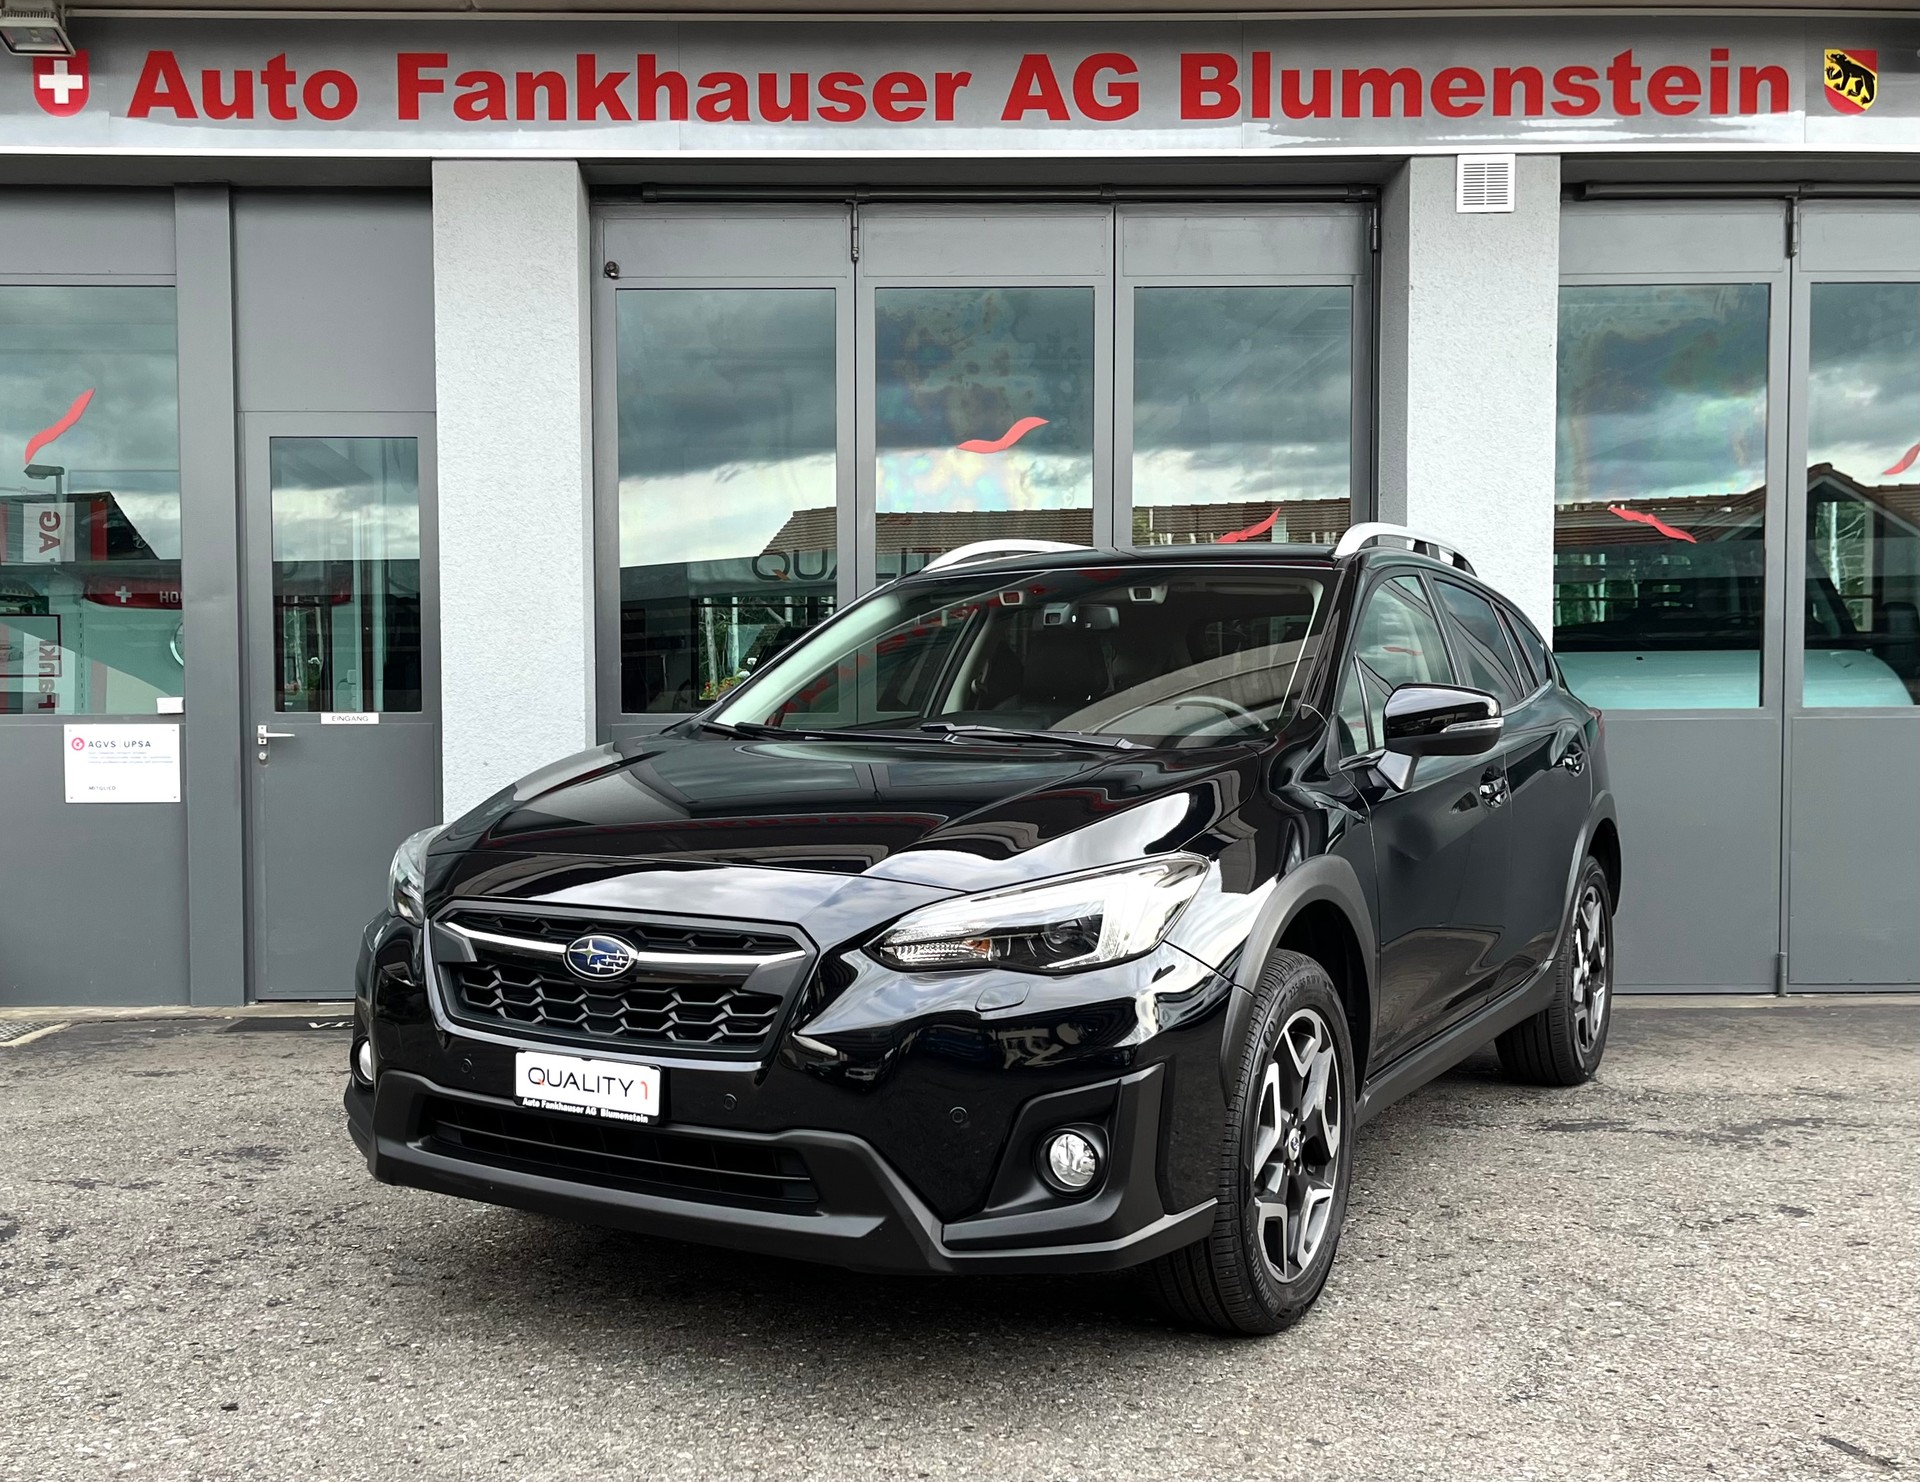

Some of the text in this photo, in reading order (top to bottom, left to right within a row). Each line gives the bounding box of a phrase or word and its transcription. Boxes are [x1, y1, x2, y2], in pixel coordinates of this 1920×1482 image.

[127, 48, 1790, 122] Auto Fankhauser AG Blumenstein
[160, 590, 182, 604] HO
[88, 740, 152, 749] AGVS UPSA
[528, 1067, 648, 1100] QUALITY 1
[522, 1097, 649, 1124] Auto Fankhauser AG Blumenstein
